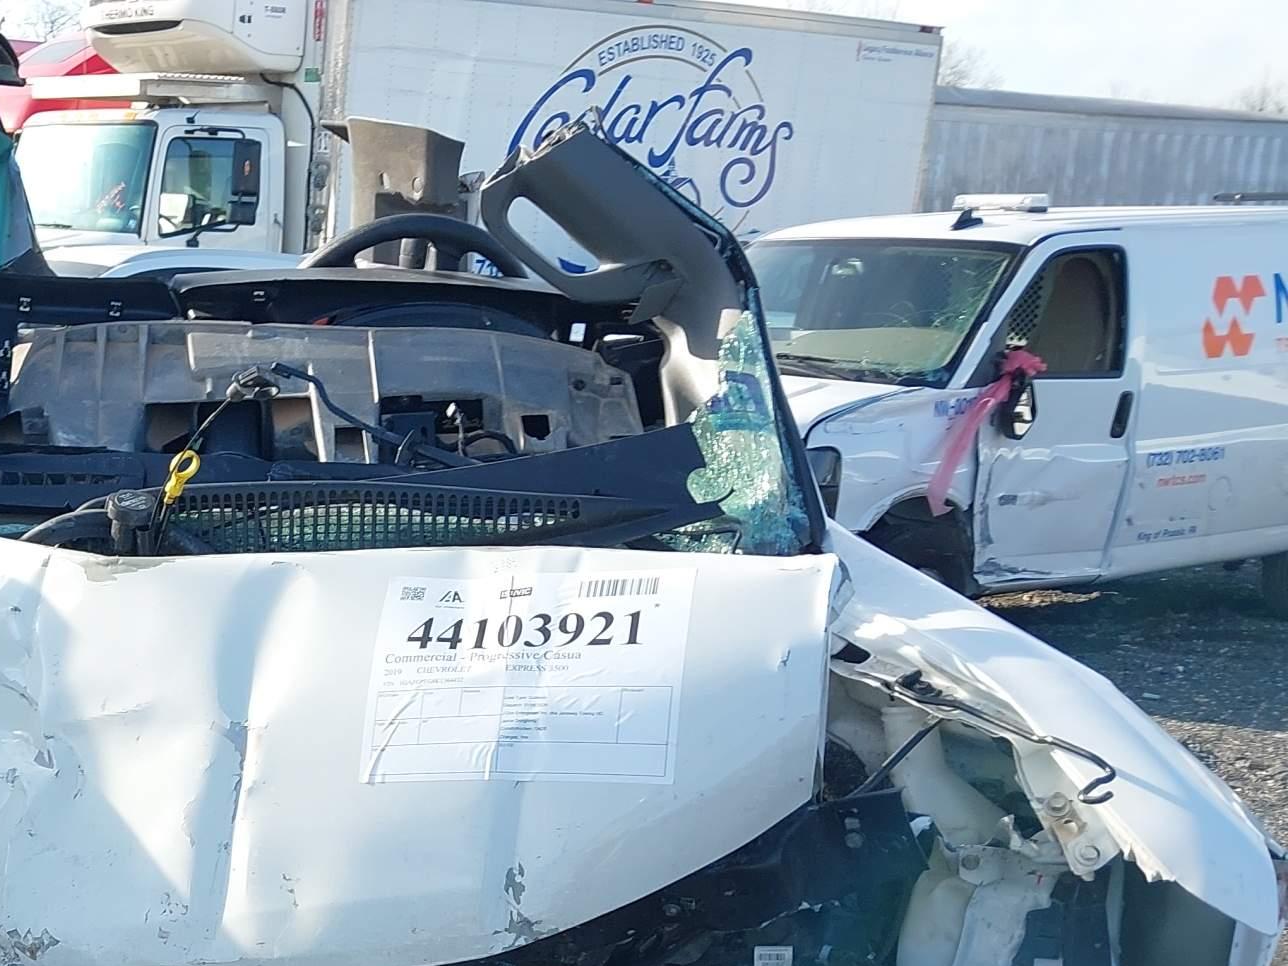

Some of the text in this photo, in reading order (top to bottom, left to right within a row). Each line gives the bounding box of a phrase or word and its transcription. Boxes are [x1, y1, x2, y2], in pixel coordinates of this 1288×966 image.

[597, 35, 717, 67] ESTABLISHED 1925
[406, 610, 645, 650] 44103921
[385, 652, 457, 664] Commercial
[543, 649, 582, 661] Casua
[505, 663, 546, 673] EXPRESS
